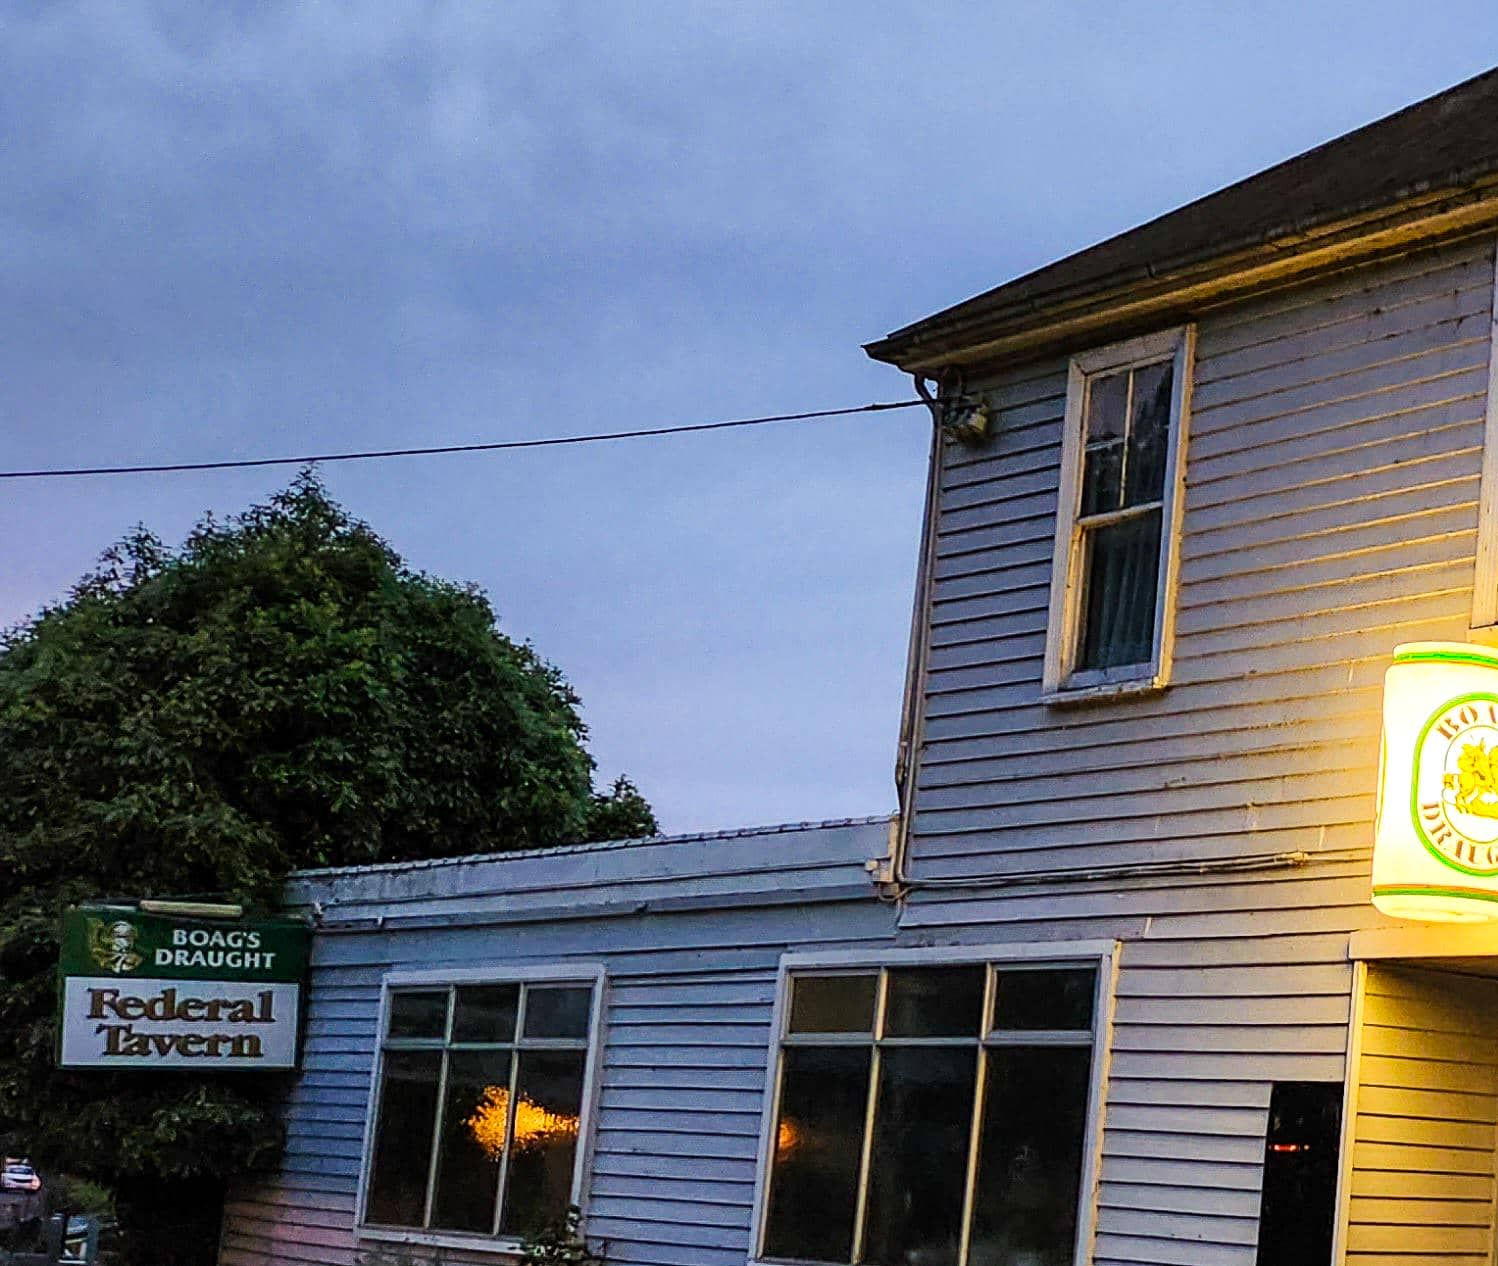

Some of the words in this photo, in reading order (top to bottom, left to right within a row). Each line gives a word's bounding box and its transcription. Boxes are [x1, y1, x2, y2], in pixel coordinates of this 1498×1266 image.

[172, 929, 261, 948] BOAG'S
[154, 948, 276, 968] DRAUGHT
[86, 987, 276, 1023] Federal
[95, 1023, 264, 1058] Tavern
